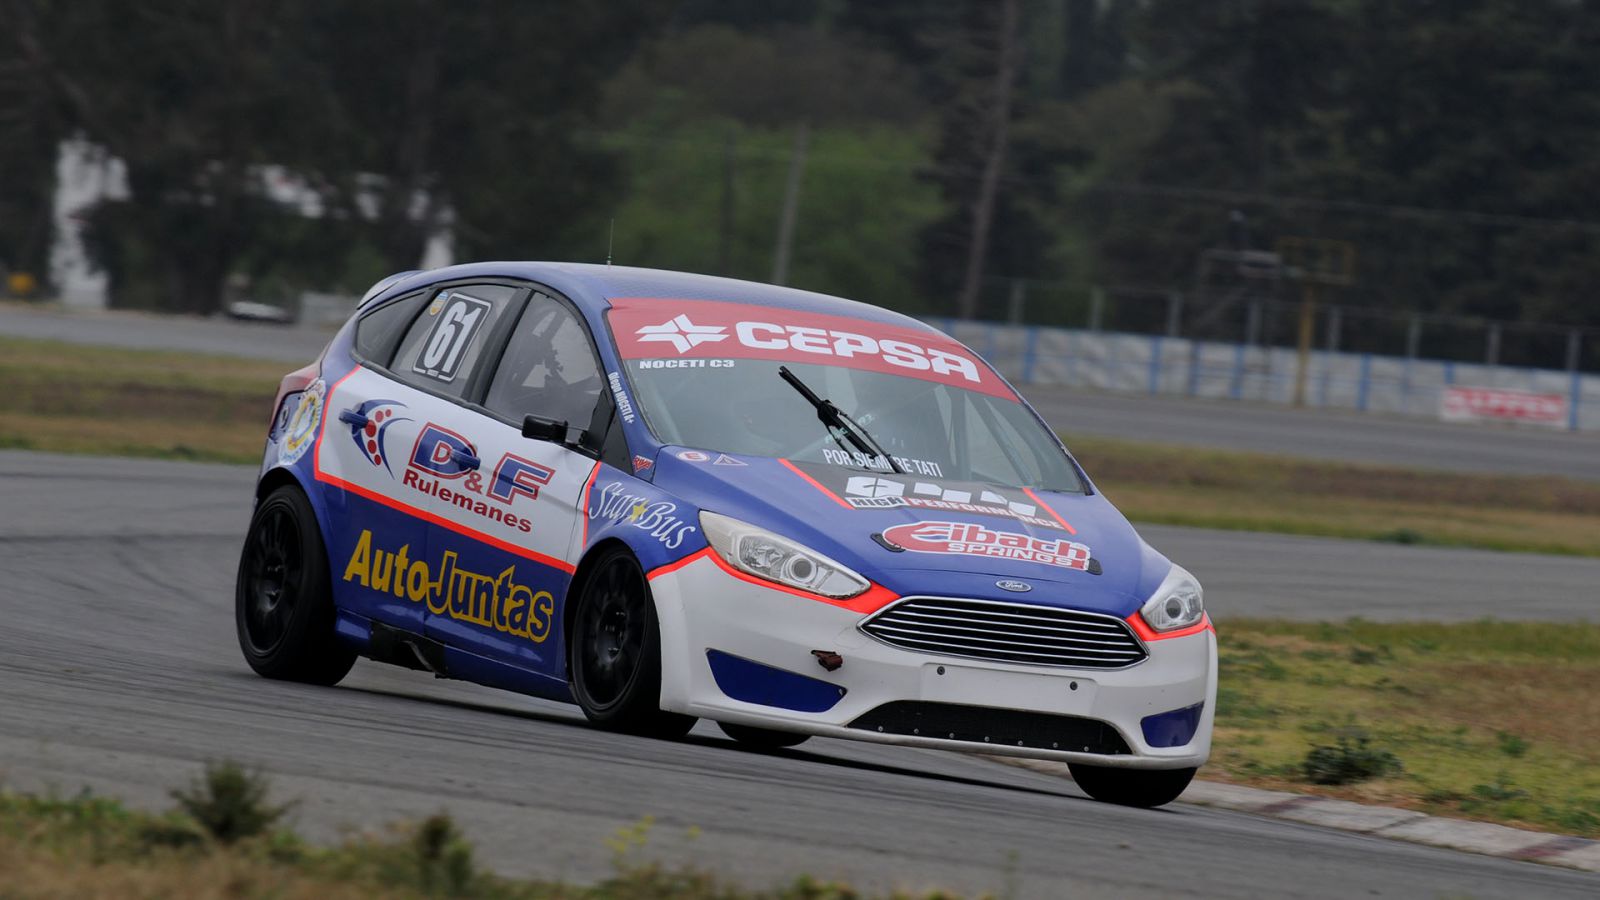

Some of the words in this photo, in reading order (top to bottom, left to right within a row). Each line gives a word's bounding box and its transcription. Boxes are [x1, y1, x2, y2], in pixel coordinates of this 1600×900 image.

[424, 301, 482, 373] 61
[735, 320, 982, 383] CEPSA
[639, 359, 704, 369] NOCETI
[709, 359, 735, 368] C3
[608, 371, 622, 392] Diego
[615, 390, 633, 415] NOCETI
[822, 449, 853, 466] POR
[852, 452, 914, 474] SIEMRE
[912, 459, 944, 478] TATI
[403, 469, 532, 533] Rulemanes
[589, 481, 646, 520] Star
[633, 502, 696, 549] Bus
[851, 496, 904, 508] HIGH
[882, 521, 1091, 562] Eibach
[946, 542, 1073, 566] SPRINGS
[343, 530, 554, 643] AutoJuntas
